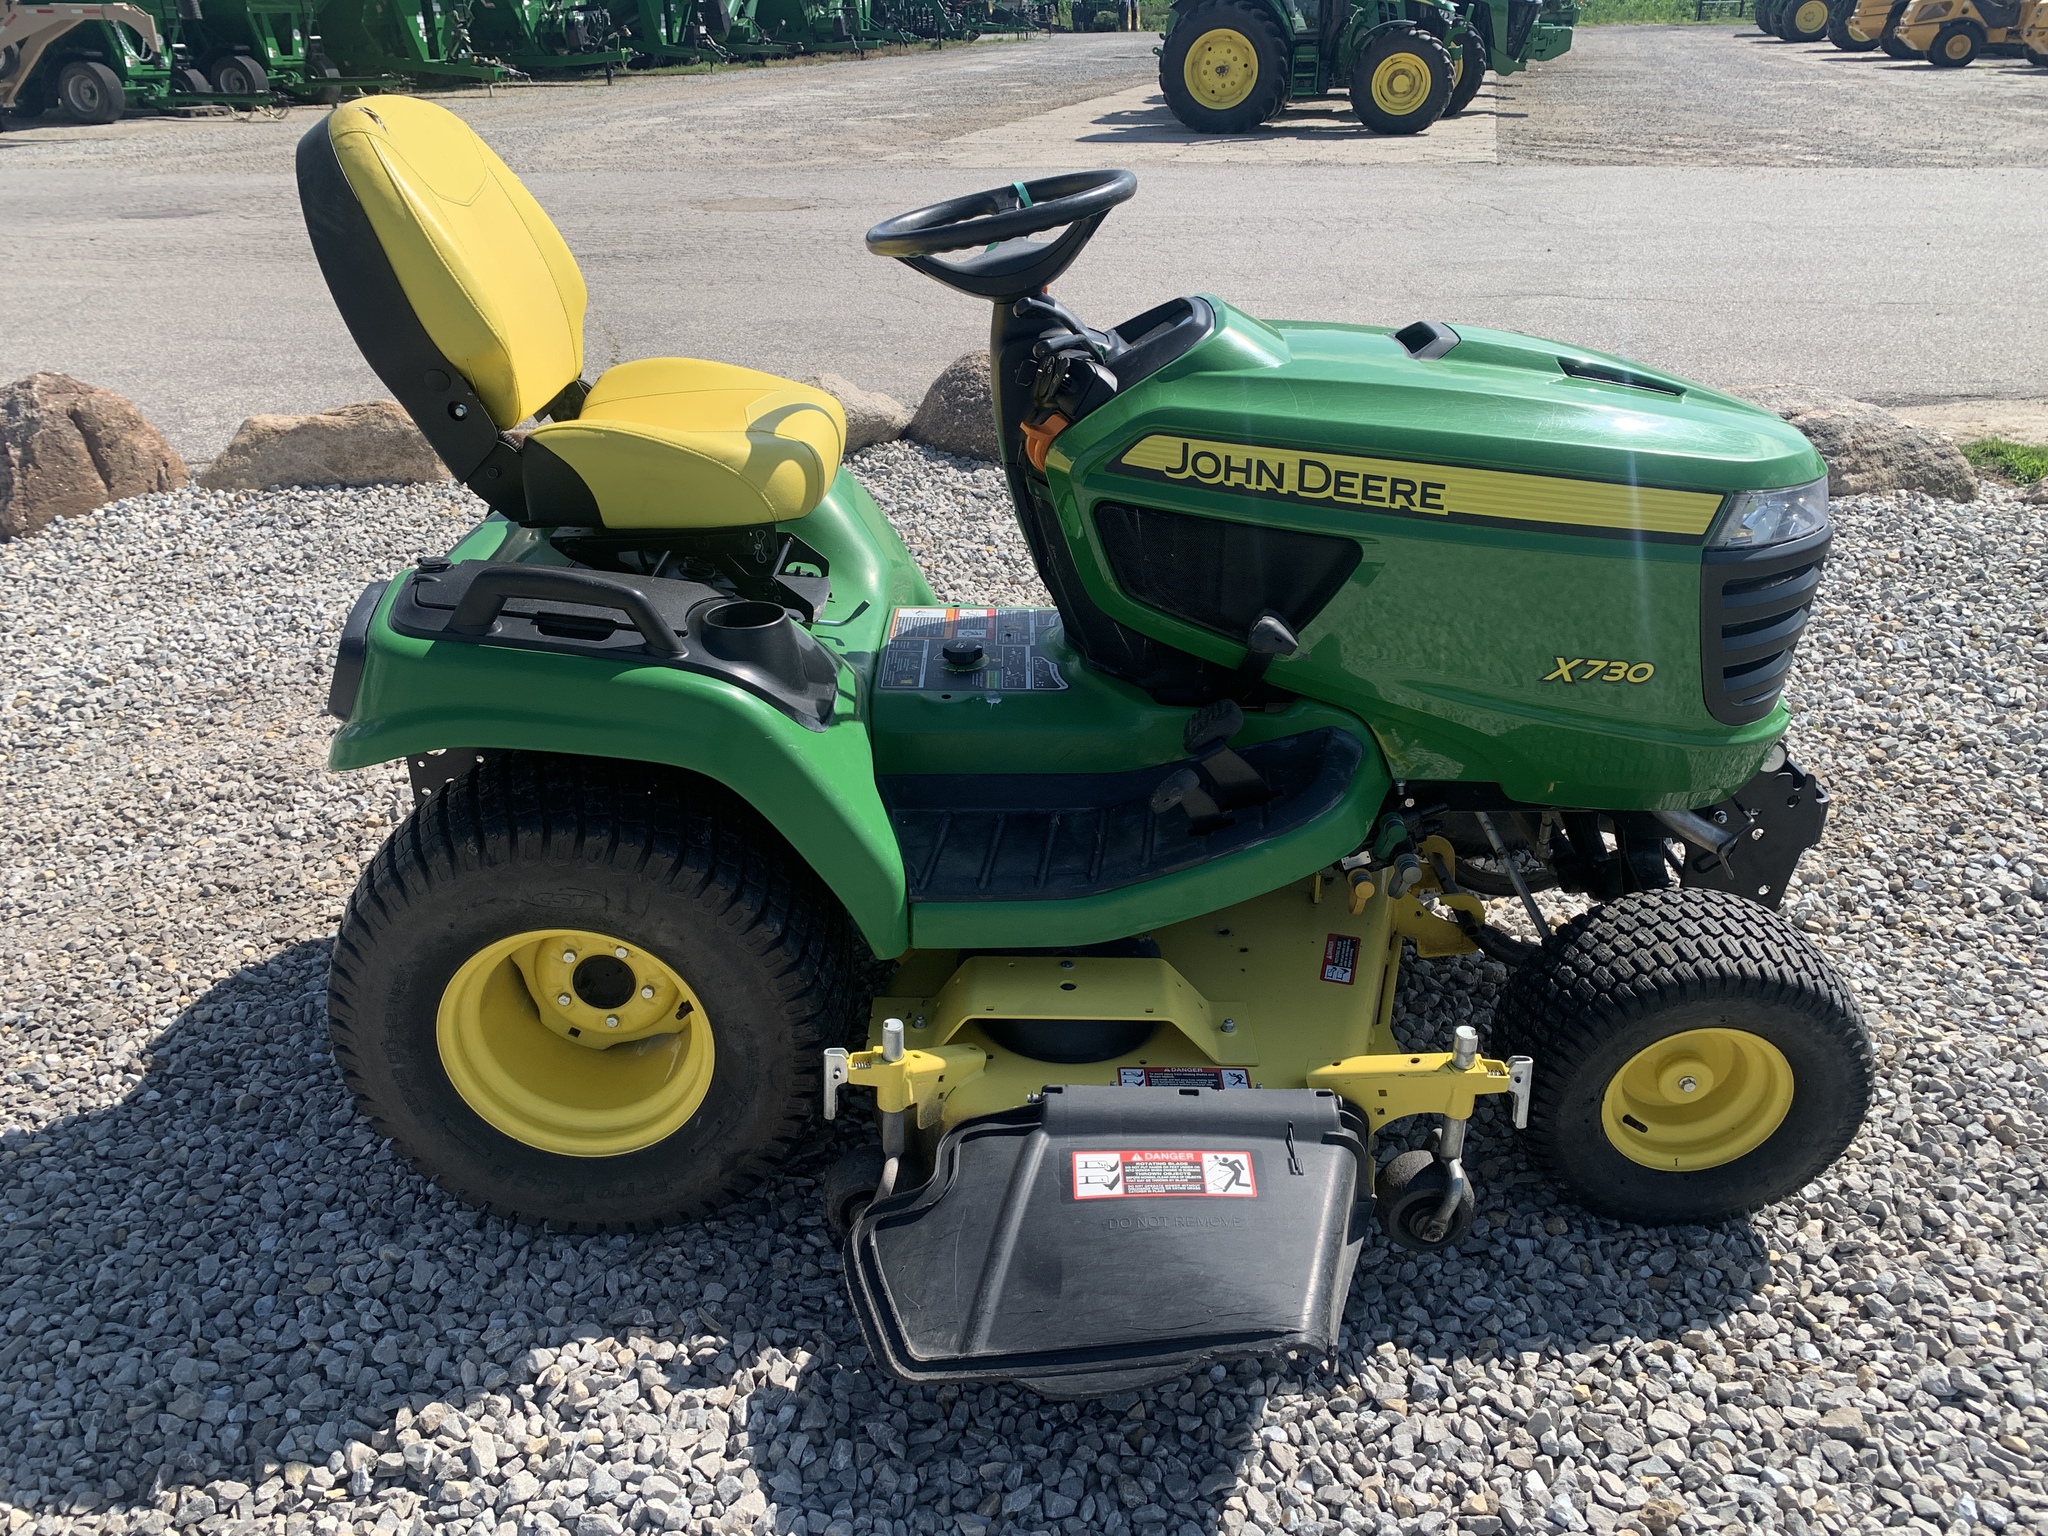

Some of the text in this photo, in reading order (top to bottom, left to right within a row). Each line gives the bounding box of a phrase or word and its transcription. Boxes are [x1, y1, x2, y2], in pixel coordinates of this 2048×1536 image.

[1165, 442, 1447, 511] JOHN DEERE
[1541, 656, 1655, 683] X730
[1108, 1216, 1242, 1229] DO NOT REMOVE
